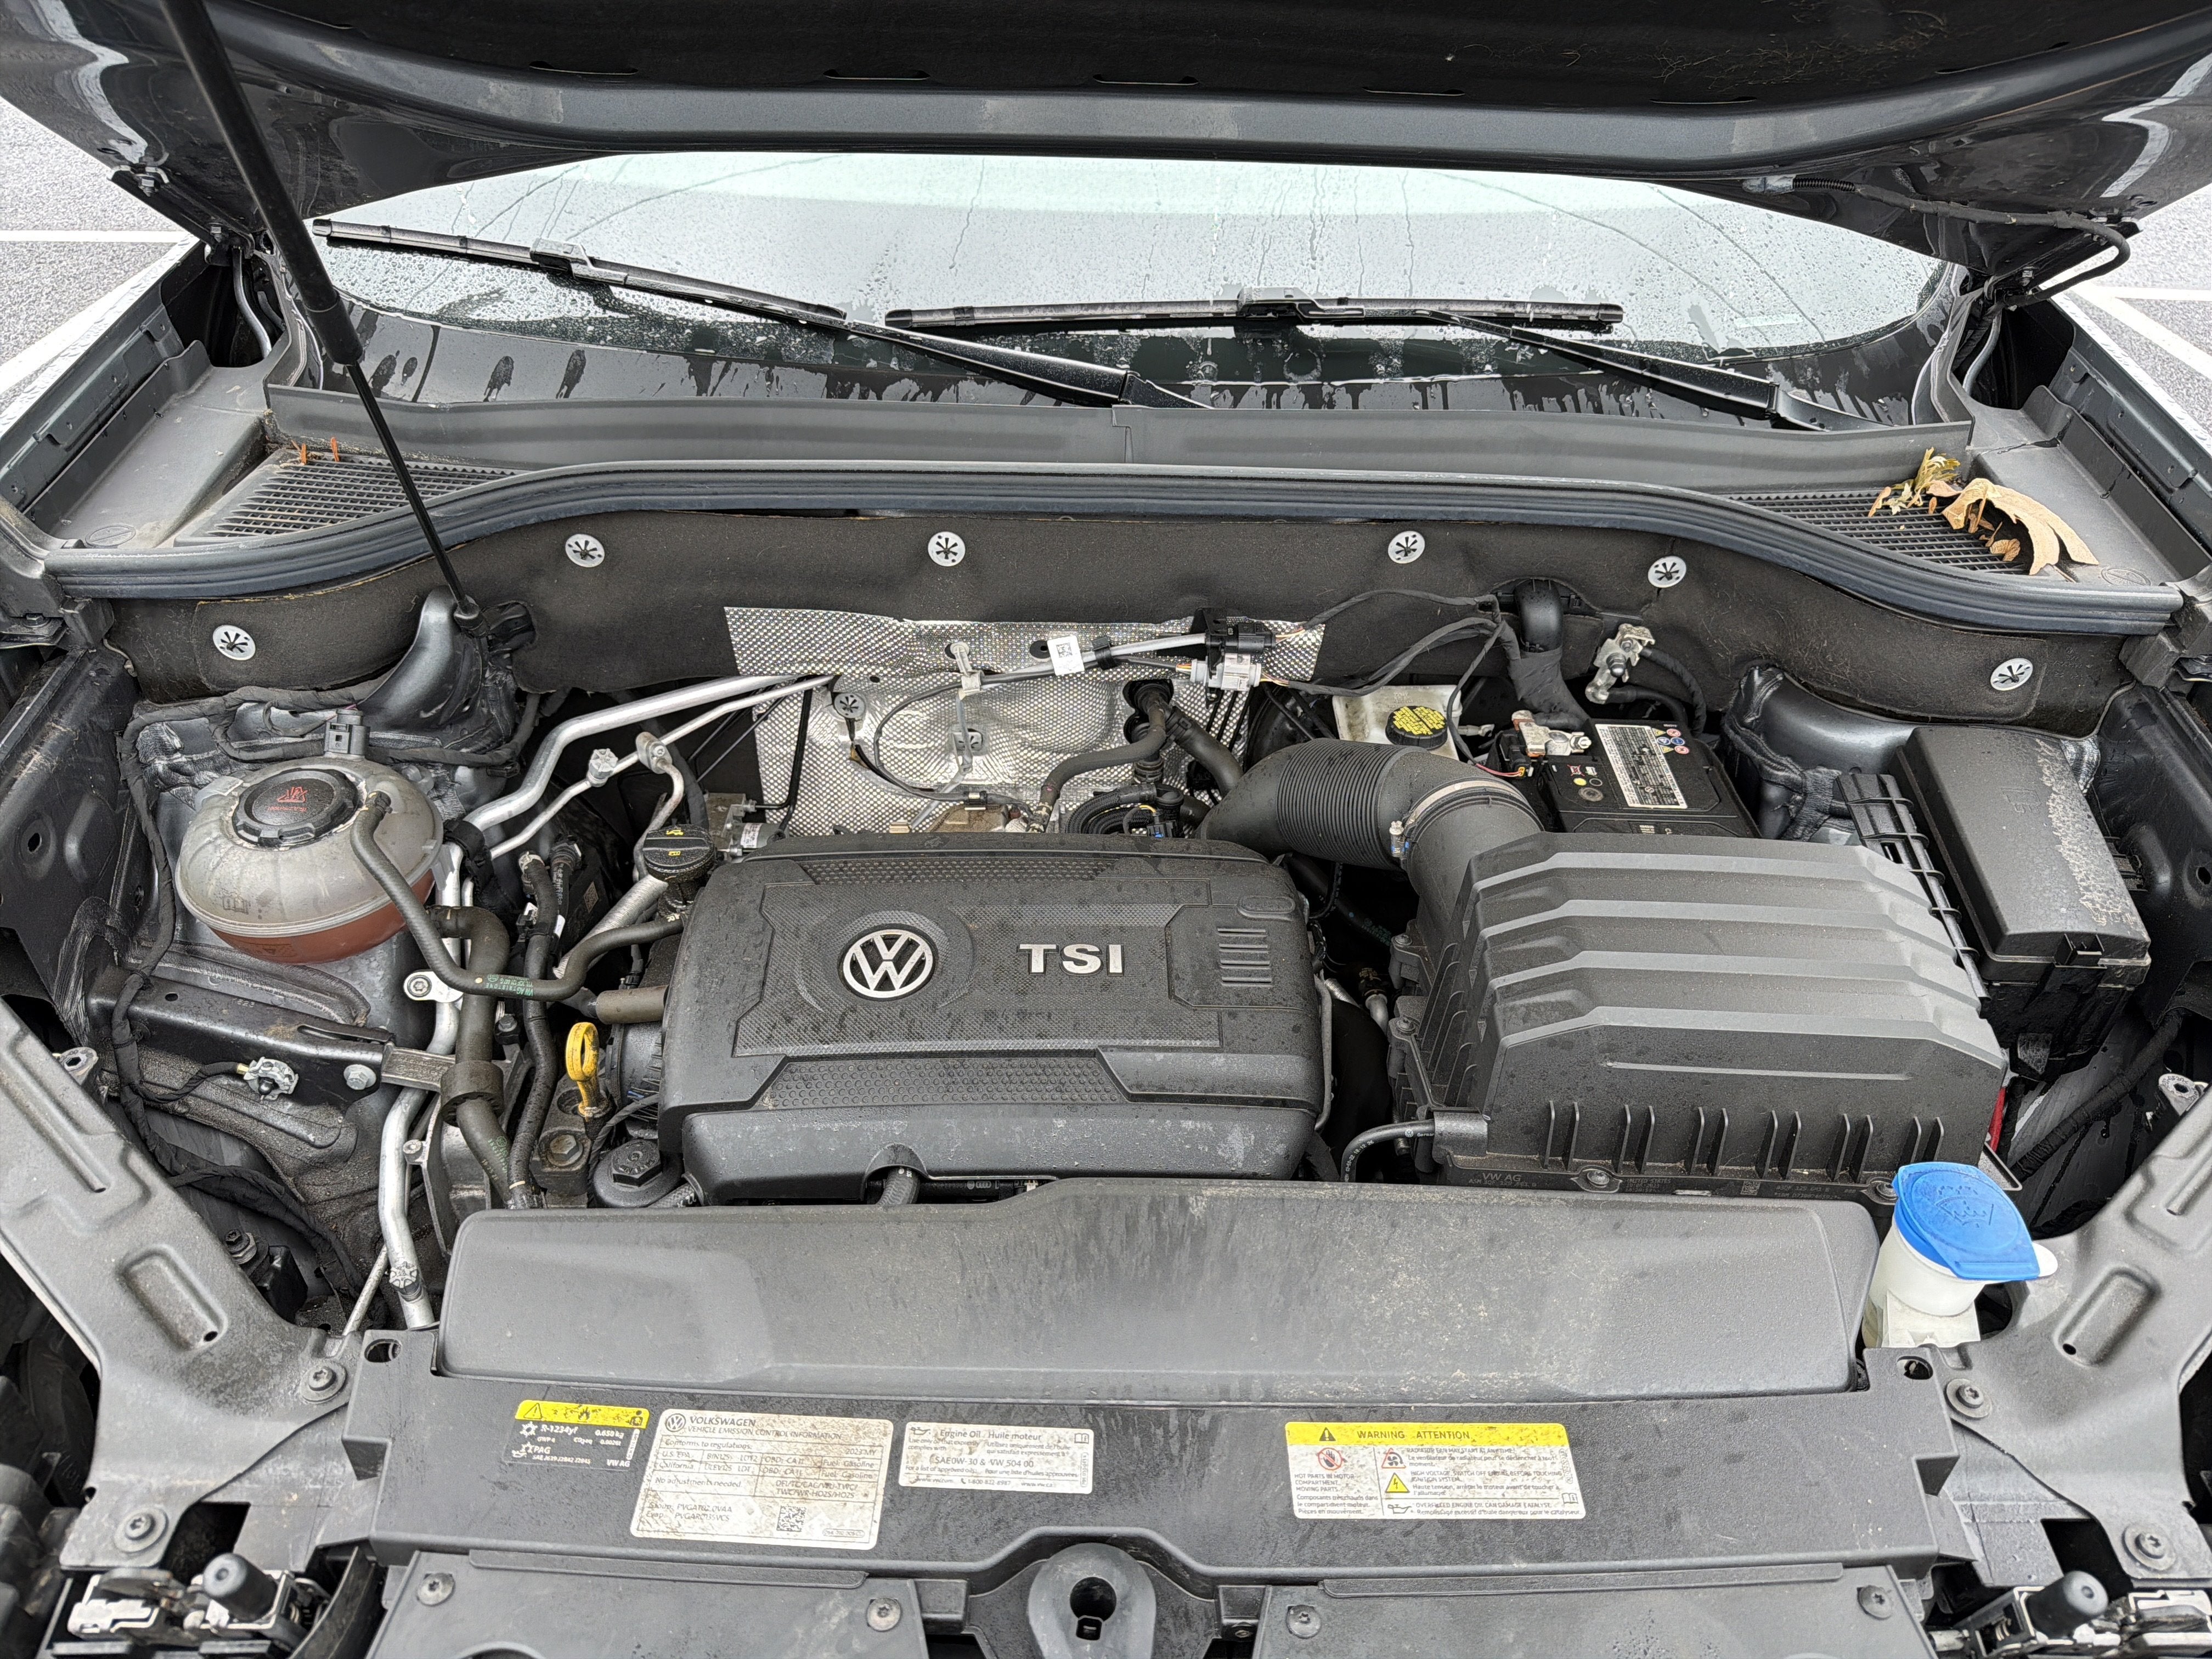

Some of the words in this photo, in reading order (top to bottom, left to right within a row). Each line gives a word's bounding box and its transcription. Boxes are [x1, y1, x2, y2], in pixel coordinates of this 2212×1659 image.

[1018, 944, 1125, 976] TSI
[1482, 1172, 1502, 1181] VW
[690, 1416, 756, 1426] VOLKSWAGEN
[616, 1430, 624, 1439] kg
[755, 1429, 788, 1437] CONTROL
[790, 1431, 842, 1440] INFORMATION
[940, 1429, 967, 1438] Engine
[989, 1431, 1009, 1439] Huile
[1012, 1432, 1042, 1441] moteur
[1357, 1430, 1406, 1440] WARNING
[1417, 1431, 1470, 1439] ATTENTION
[665, 1438, 699, 1447] Conforms
[667, 1478, 713, 1487] adjustments
